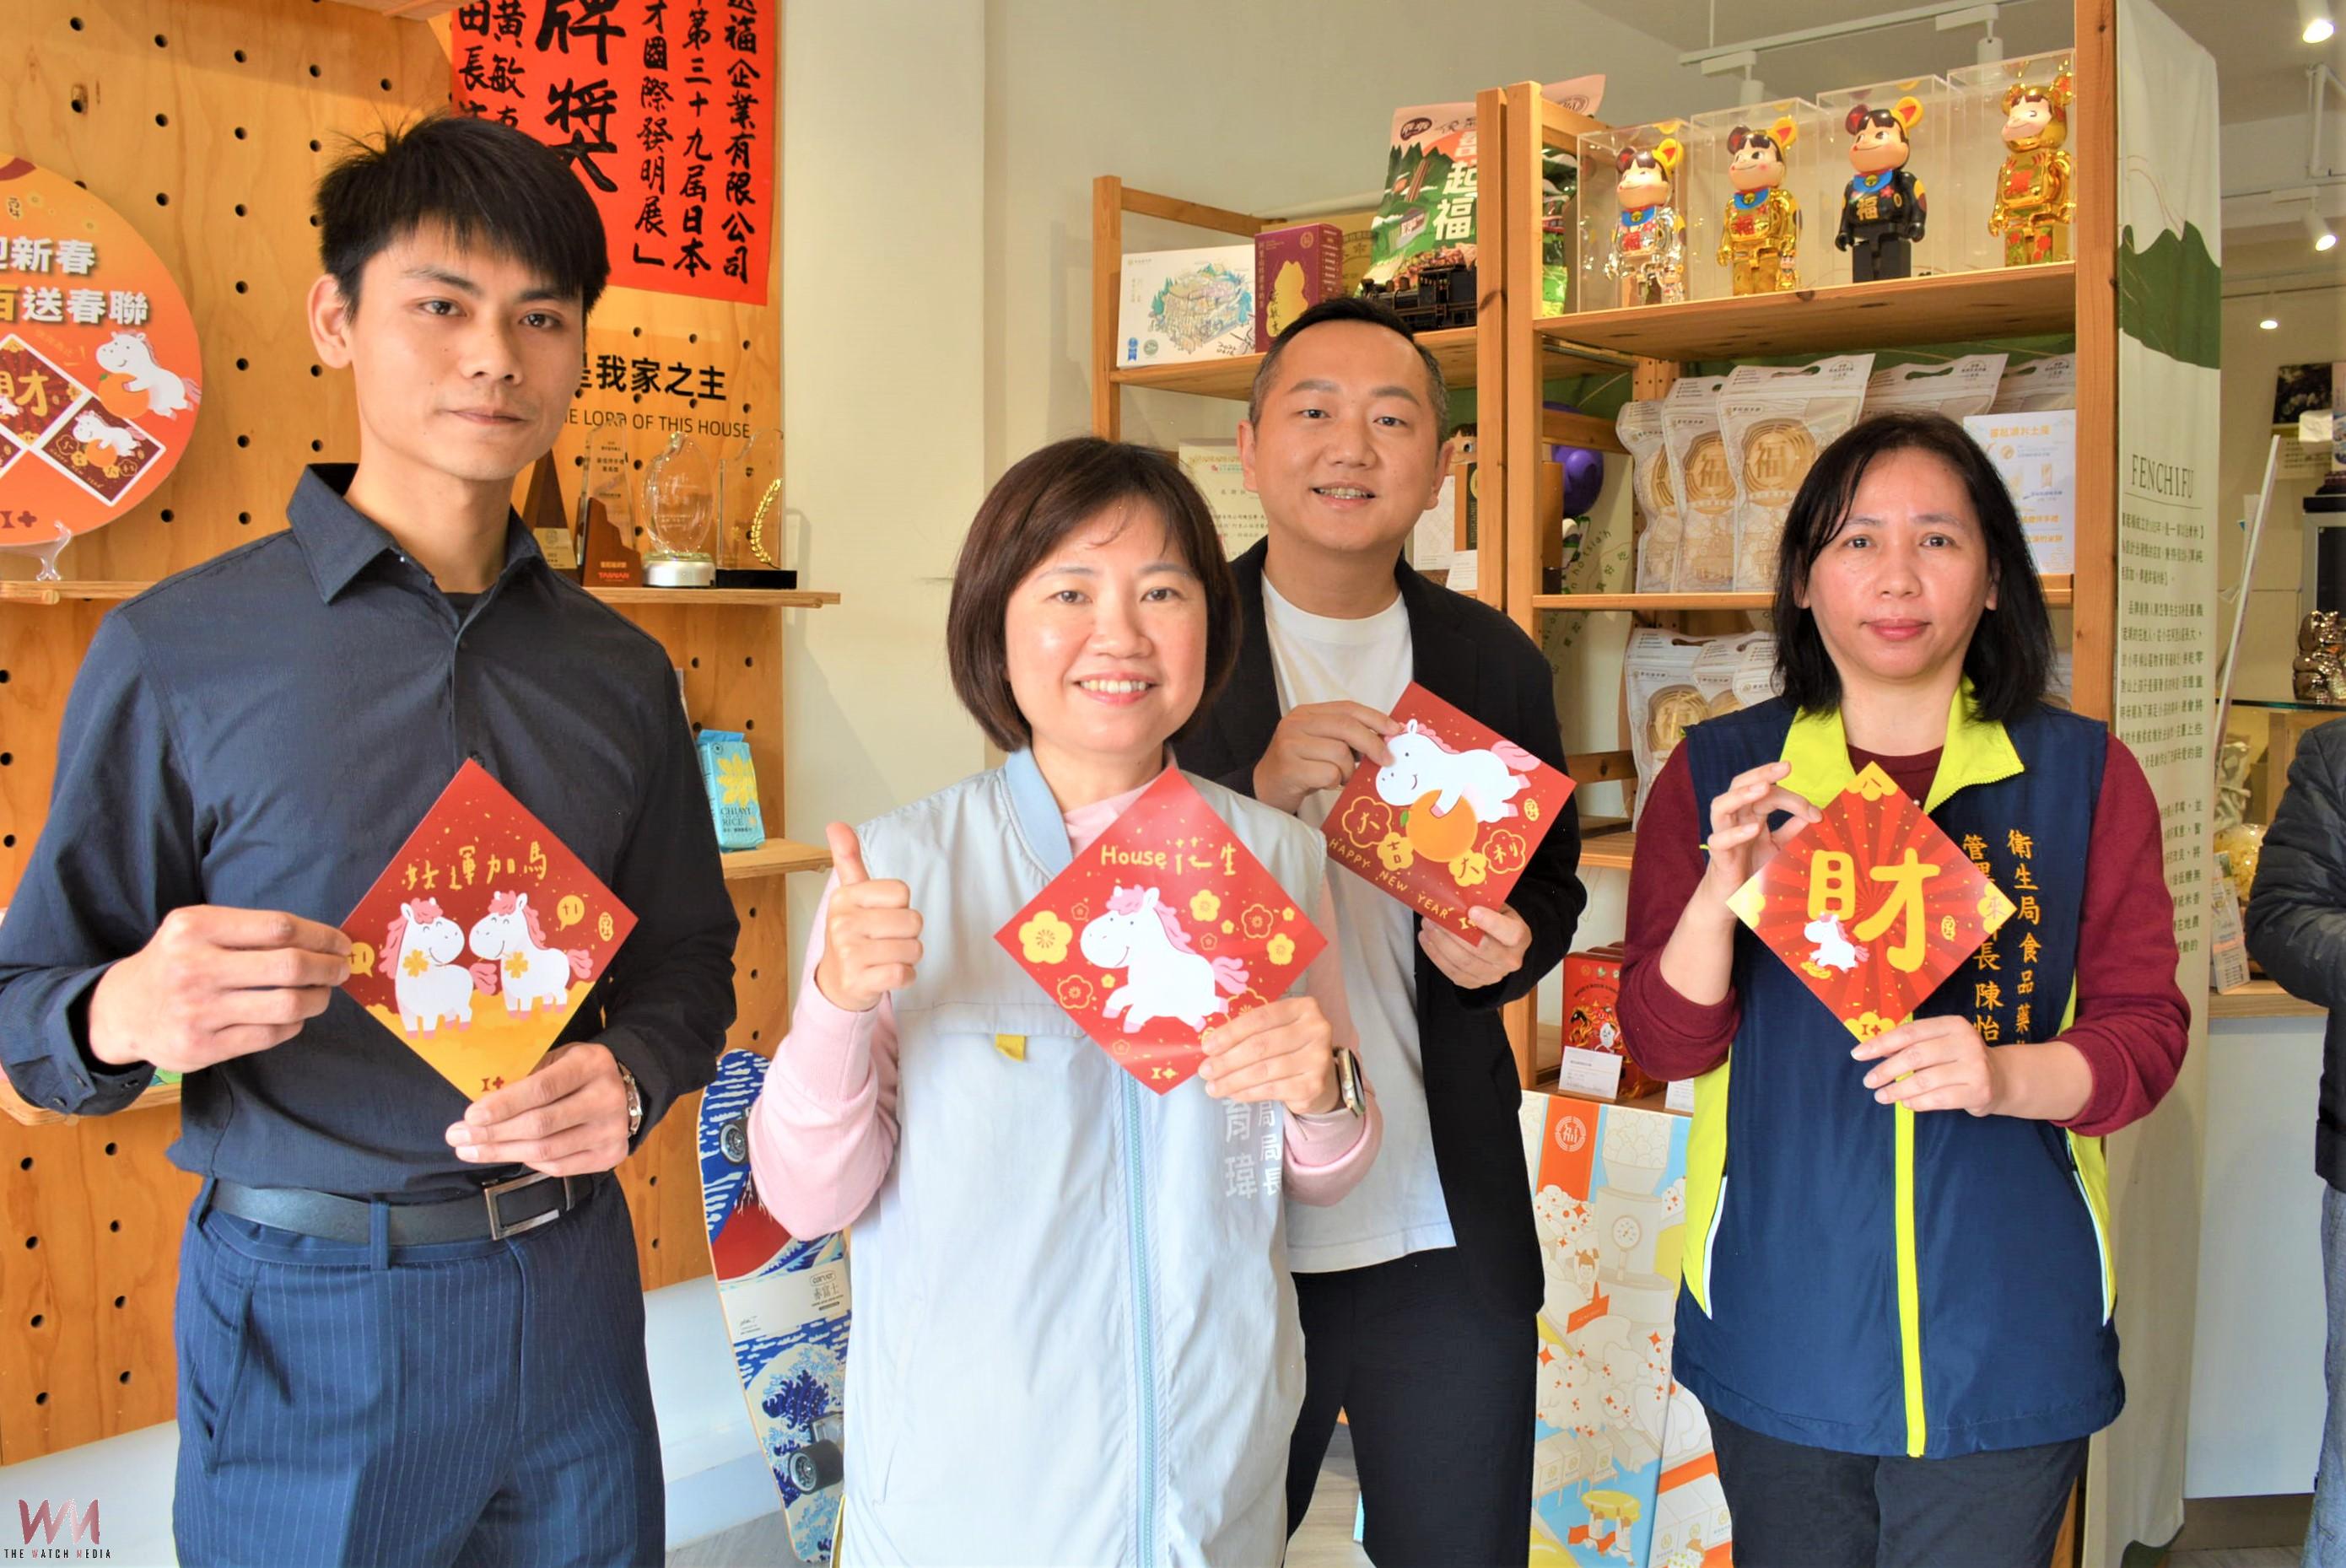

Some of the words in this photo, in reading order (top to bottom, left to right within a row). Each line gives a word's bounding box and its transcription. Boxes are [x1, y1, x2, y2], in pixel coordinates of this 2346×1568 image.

[673, 0, 714, 277] 第三十九屆日本
[0, 235, 95, 275] 新春
[584, 409, 627, 428] LORD
[633, 413, 654, 430] OF
[658, 416, 693, 434] THIS
[698, 419, 750, 439] HOUSE
[722, 817, 744, 827] RICE
[1100, 843, 1168, 870] House
[1329, 838, 1371, 869] HAPPY
[1378, 870, 1408, 892] NEW
[1416, 892, 1449, 919] YEAR
[1807, 847, 1941, 973] 財
[2007, 828, 2042, 1045] 衛生局食品藥
